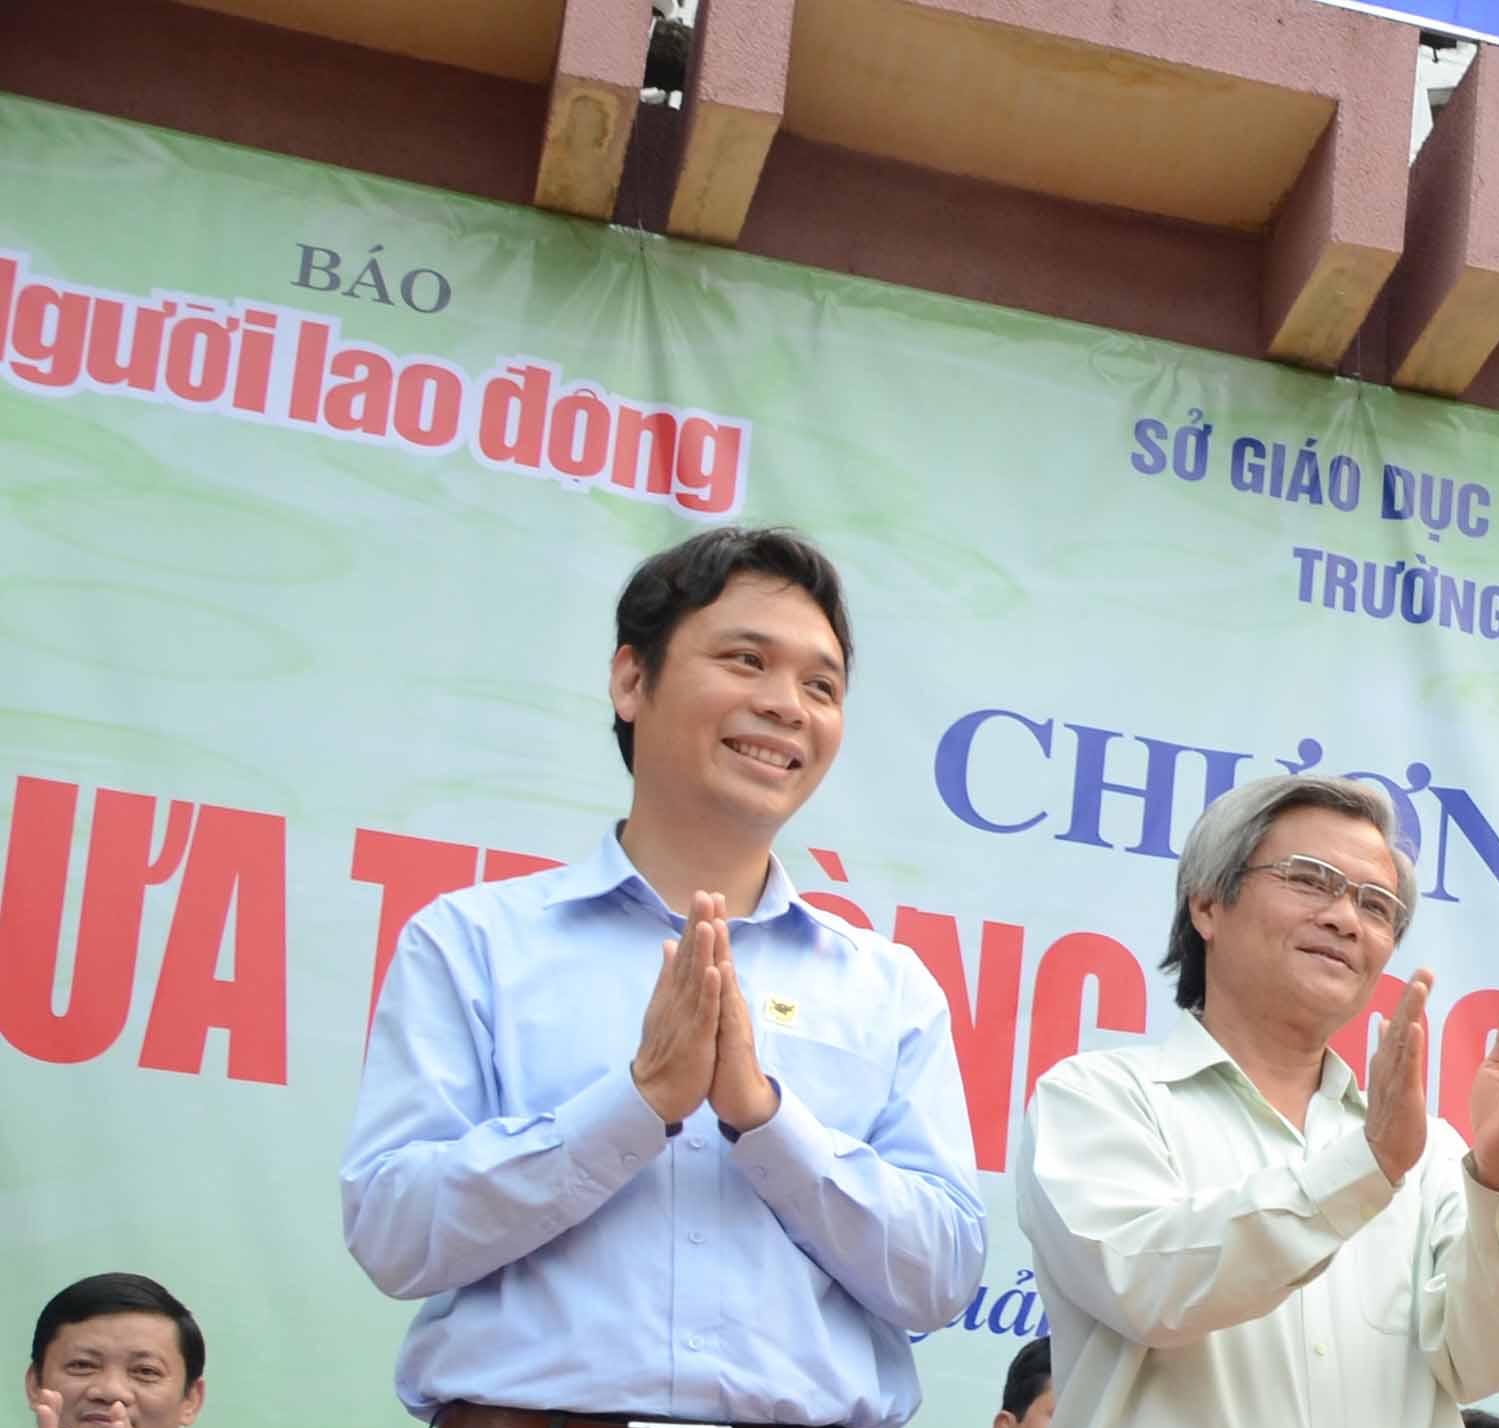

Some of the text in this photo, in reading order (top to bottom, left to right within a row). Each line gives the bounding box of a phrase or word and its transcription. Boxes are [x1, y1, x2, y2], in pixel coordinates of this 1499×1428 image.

[291, 242, 452, 314] BÁO
[287, 320, 462, 447] lao
[478, 363, 742, 513] động
[1130, 407, 1212, 482] SỞ
[1229, 436, 1362, 512] GIÁO
[1380, 463, 1492, 543] DỤC
